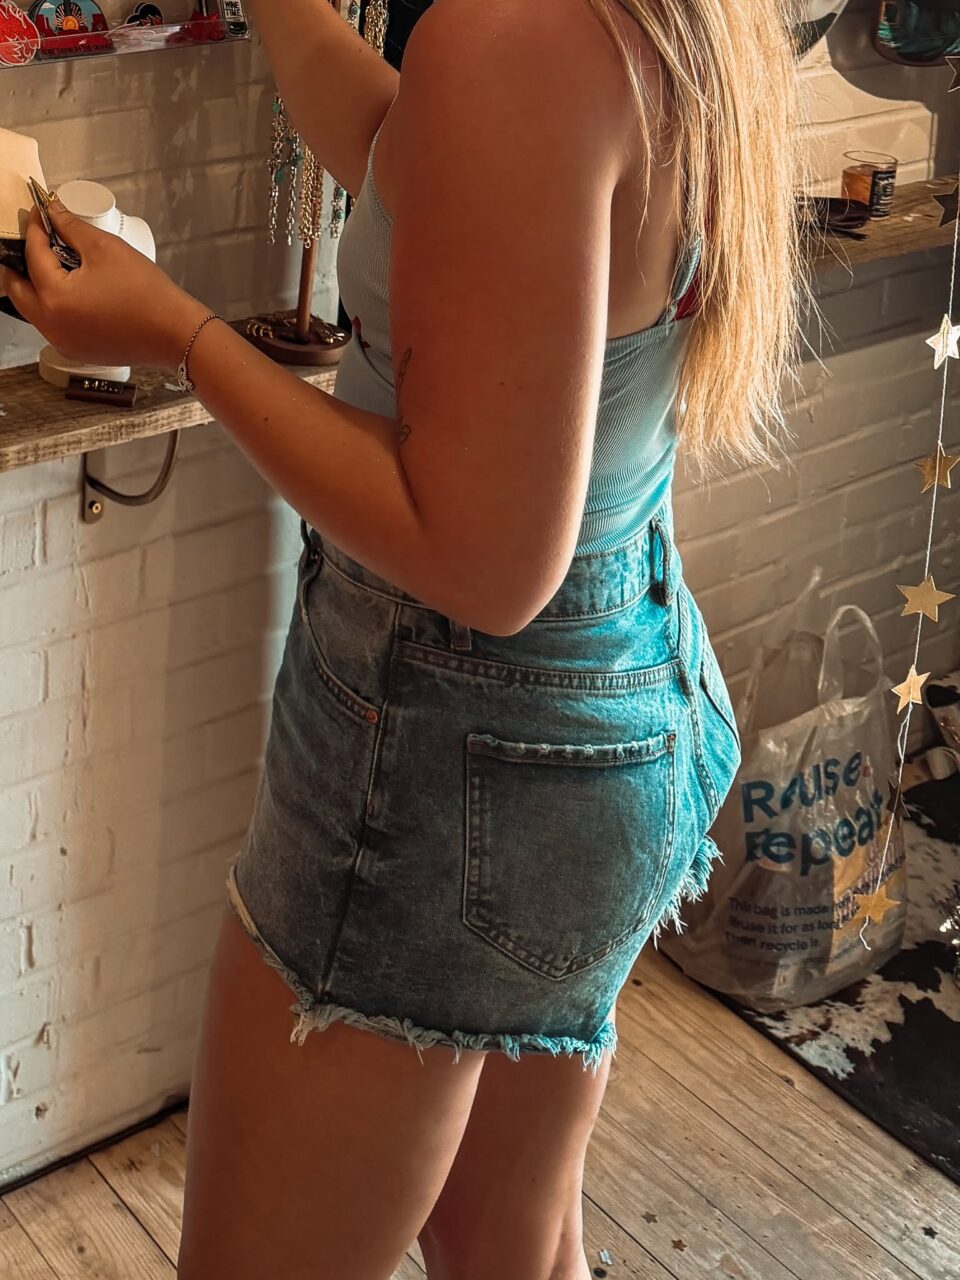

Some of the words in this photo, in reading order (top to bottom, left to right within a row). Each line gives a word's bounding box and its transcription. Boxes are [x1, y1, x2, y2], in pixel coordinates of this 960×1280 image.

[753, 901, 778, 919] bag
[781, 903, 791, 917] is
[794, 903, 829, 917] made
[780, 923, 798, 935] for
[801, 923, 815, 932] as
[760, 939, 808, 953] recycle
[811, 937, 819, 947] it
